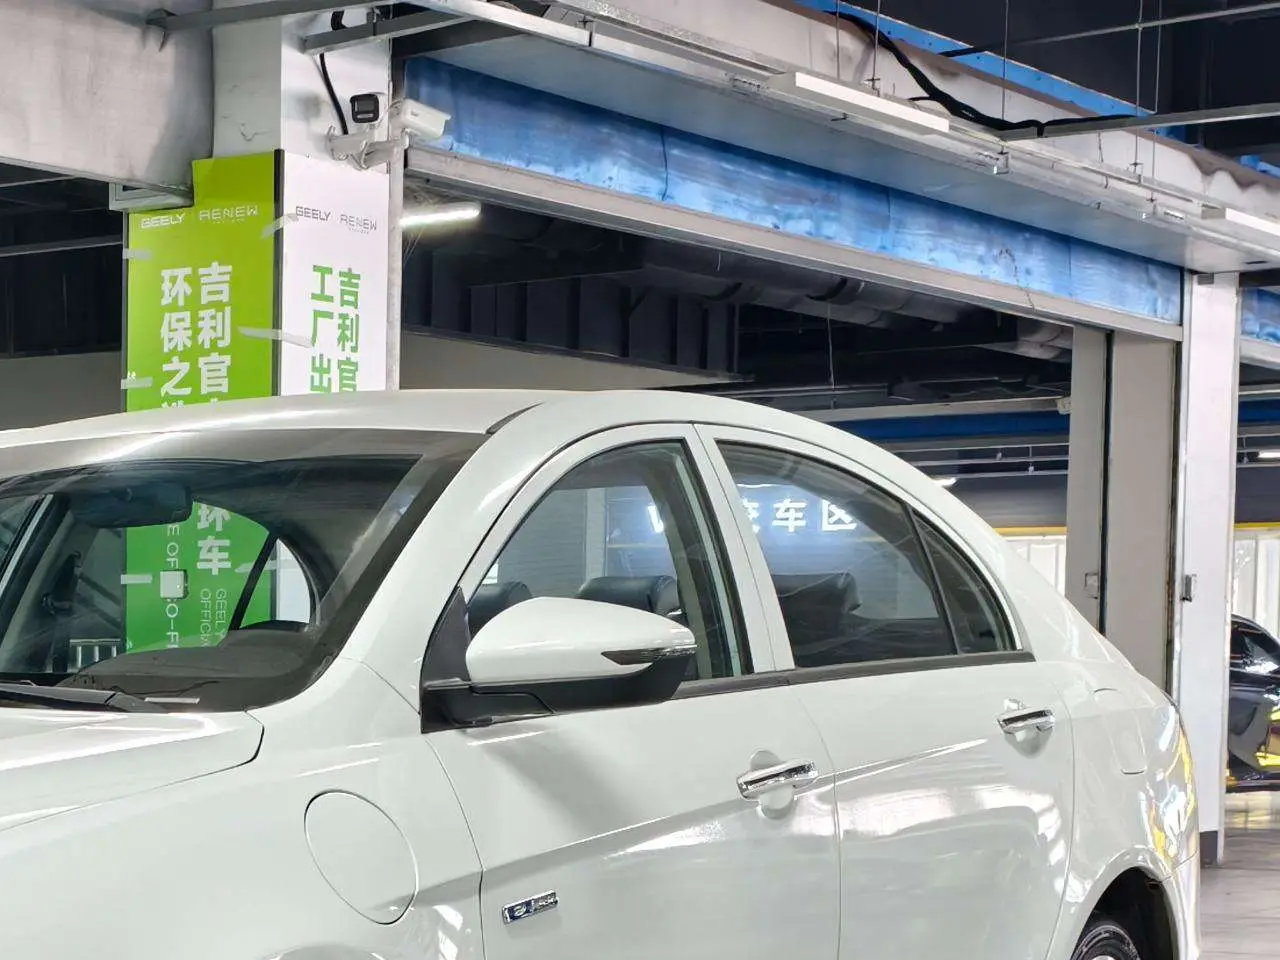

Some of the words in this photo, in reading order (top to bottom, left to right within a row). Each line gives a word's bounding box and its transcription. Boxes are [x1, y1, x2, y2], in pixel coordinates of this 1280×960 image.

[140, 212, 186, 229] GEELY
[296, 206, 331, 221] GEELY
[160, 266, 192, 407] 环保之
[198, 261, 233, 402] 吉利官
